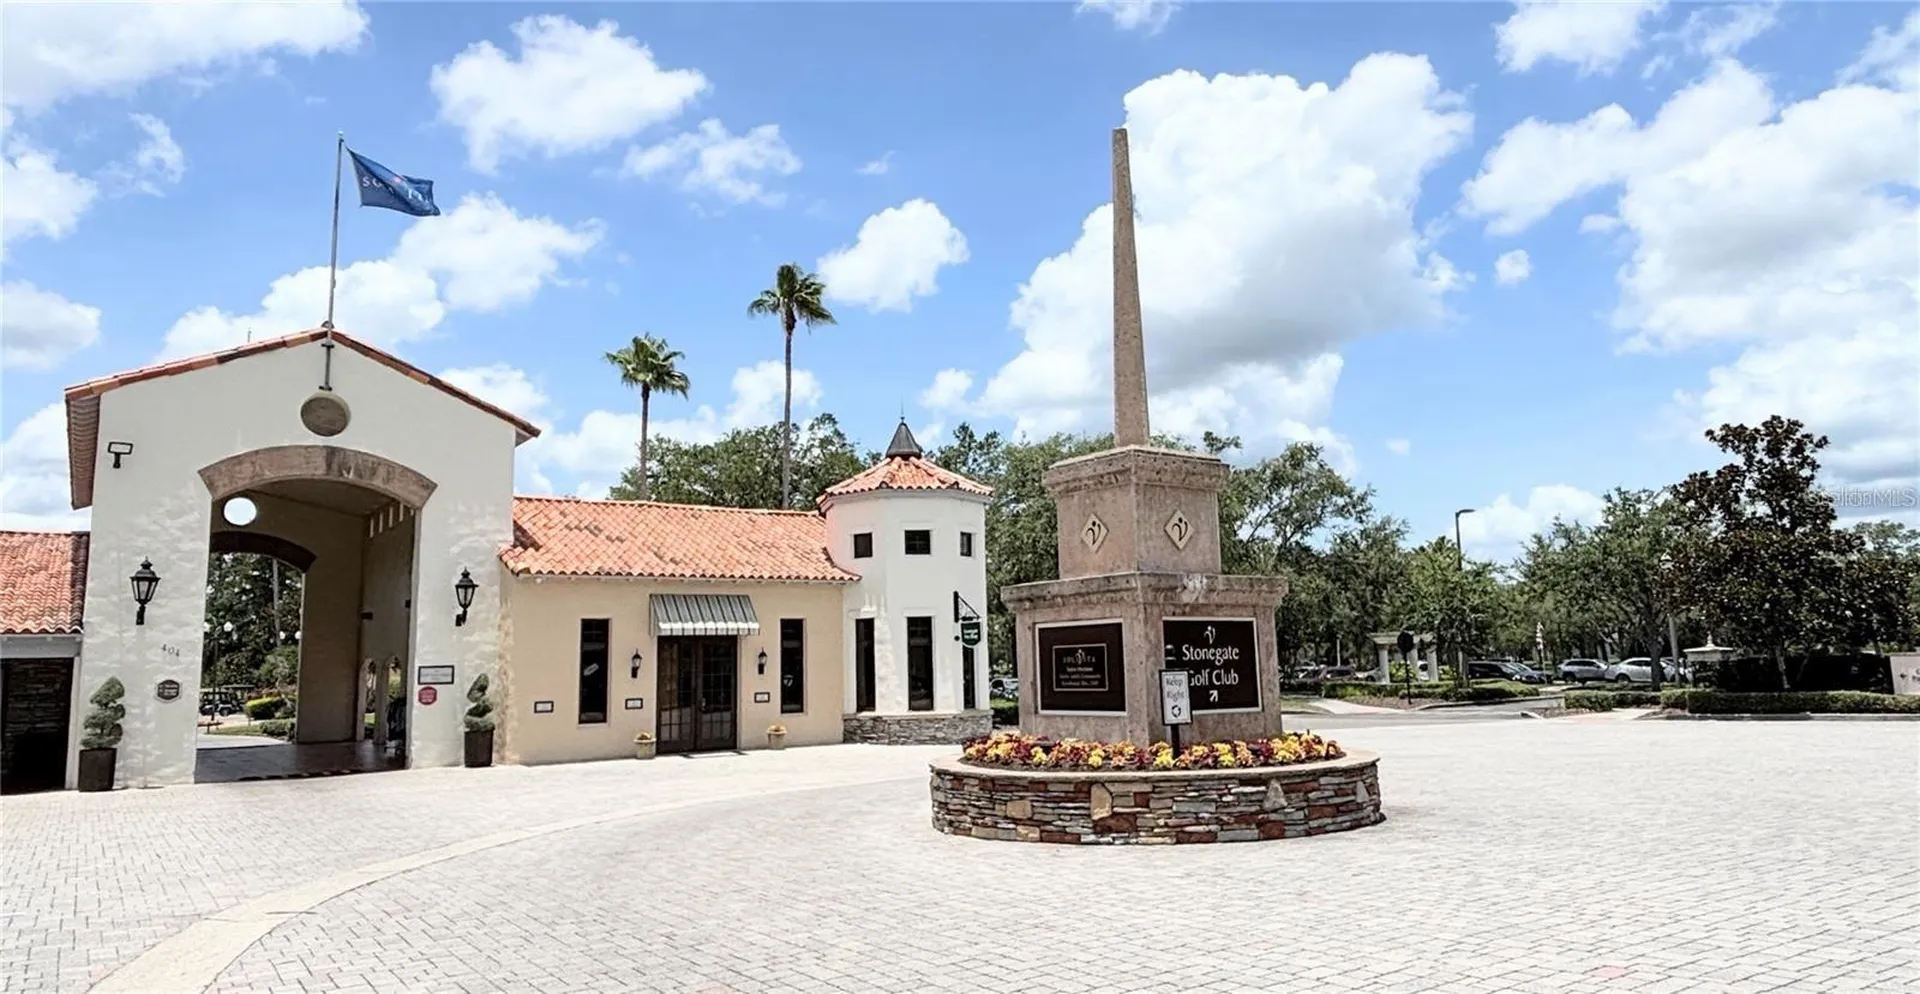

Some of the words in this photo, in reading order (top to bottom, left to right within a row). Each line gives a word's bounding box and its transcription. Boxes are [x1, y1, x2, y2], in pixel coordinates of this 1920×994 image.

[161, 644, 180, 657] 404
[1182, 644, 1239, 666] Stonegate
[1212, 668, 1239, 686] Club
